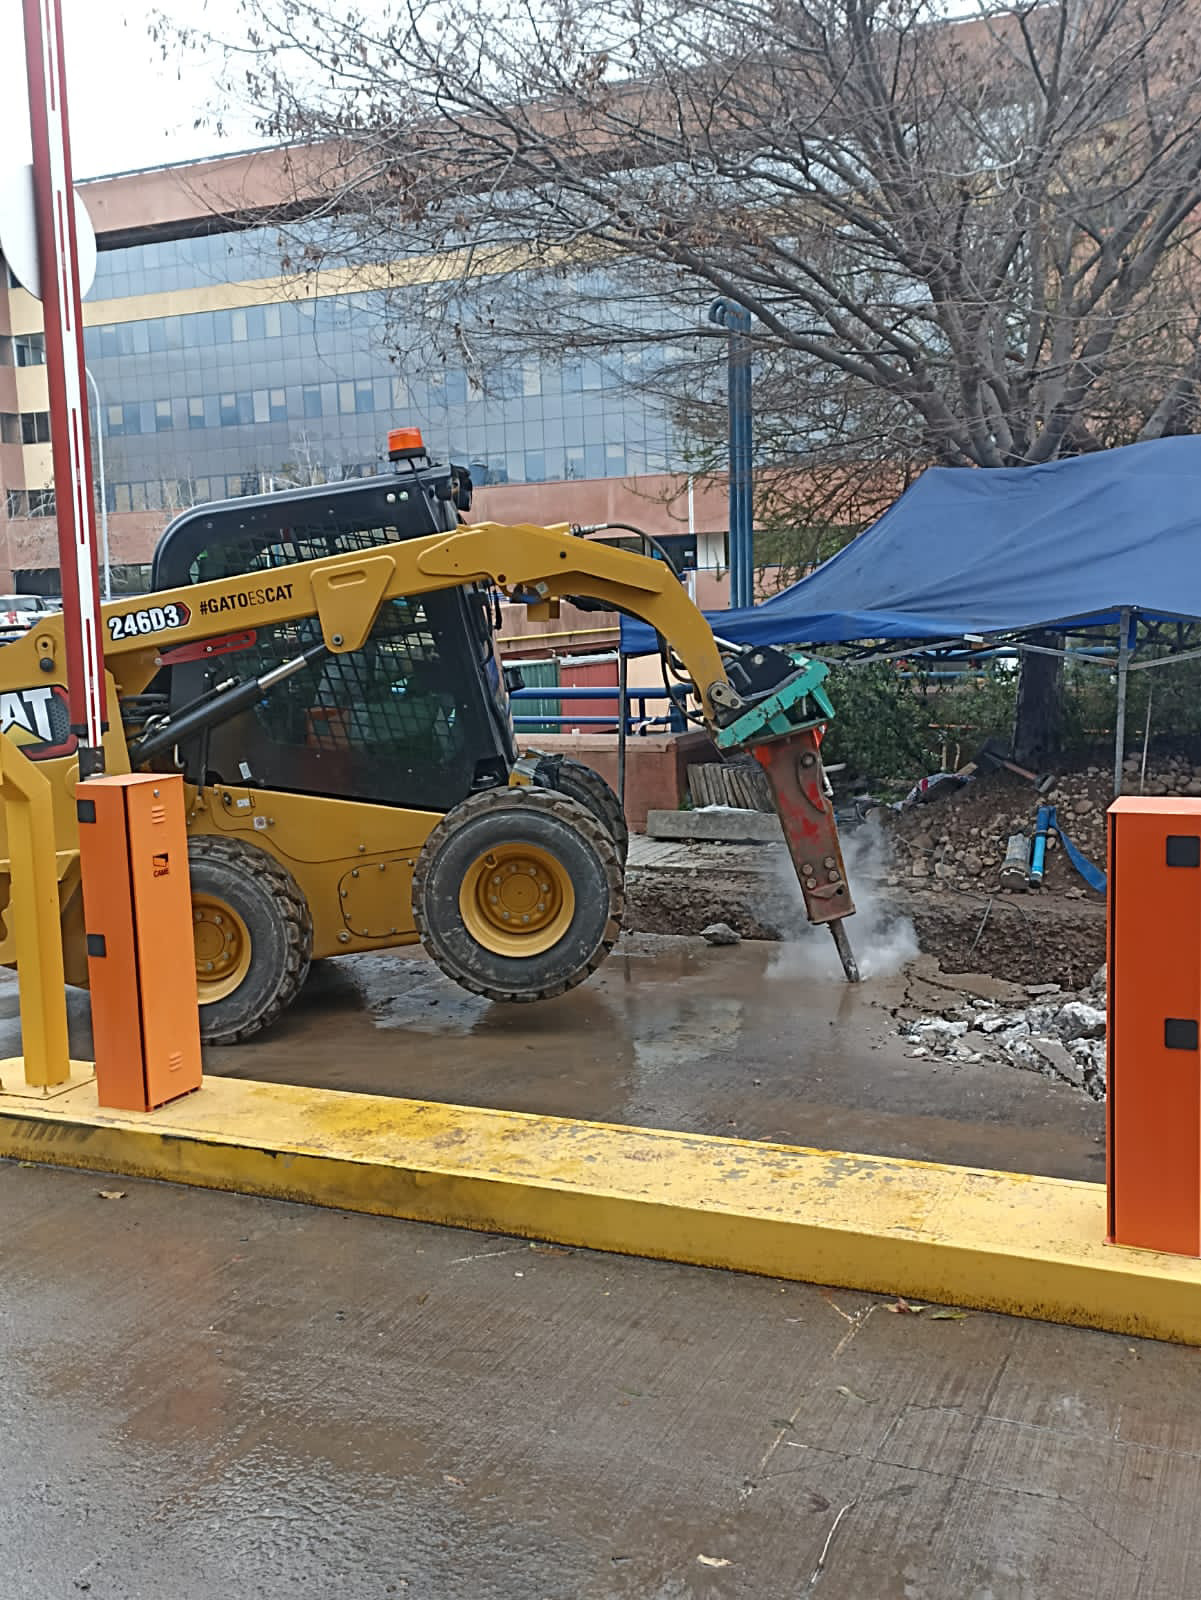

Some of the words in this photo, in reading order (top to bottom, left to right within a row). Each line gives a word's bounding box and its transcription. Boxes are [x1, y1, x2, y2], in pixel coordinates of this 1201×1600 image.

[199, 583, 294, 616] #GATOESCAT
[108, 603, 181, 641] 246D3
[0, 687, 53, 742] AT
